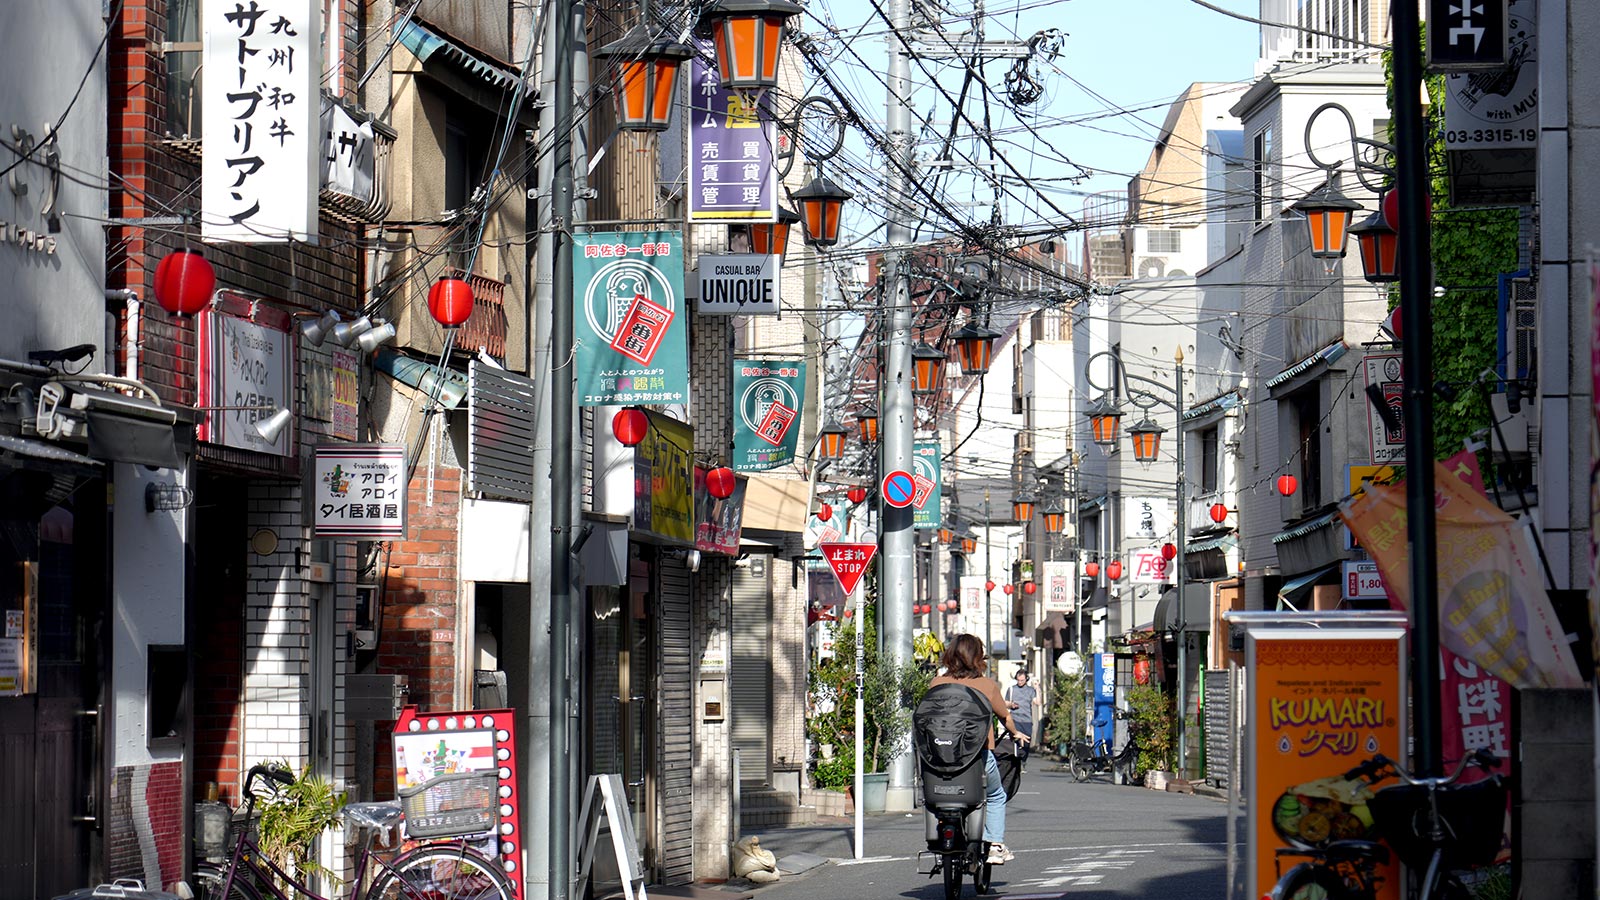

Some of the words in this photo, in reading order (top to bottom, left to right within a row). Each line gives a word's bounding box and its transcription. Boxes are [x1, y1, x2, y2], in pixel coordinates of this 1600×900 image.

[265, 15, 298, 148] 九州和牛
[223, 0, 268, 223] サトーブリアン
[1486, 110, 1512, 120] with
[1446, 129, 1537, 143] 03-3315-19
[701, 141, 761, 159] 売買
[701, 164, 761, 182] 賃貸
[701, 187, 761, 205] 管理
[585, 243, 670, 258] 阿佐谷一番街
[715, 265, 742, 276] CASUAL
[745, 265, 761, 276] BAR
[702, 278, 774, 306] UNIQUE
[600, 368, 665, 377] 人と人とのつながり
[584, 391, 683, 403] コロナ感染予防対策中
[361, 473, 398, 484] アロイ
[361, 488, 398, 499] アロイ
[320, 503, 398, 519] タイ居酒屋
[1141, 501, 1153, 531] もつ焼
[831, 549, 867, 561] 止まれ
[837, 563, 862, 573] STOP
[1360, 579, 1385, 589] 1,80
[1270, 697, 1385, 730] KUMARI
[1299, 730, 1358, 757] クマリ
